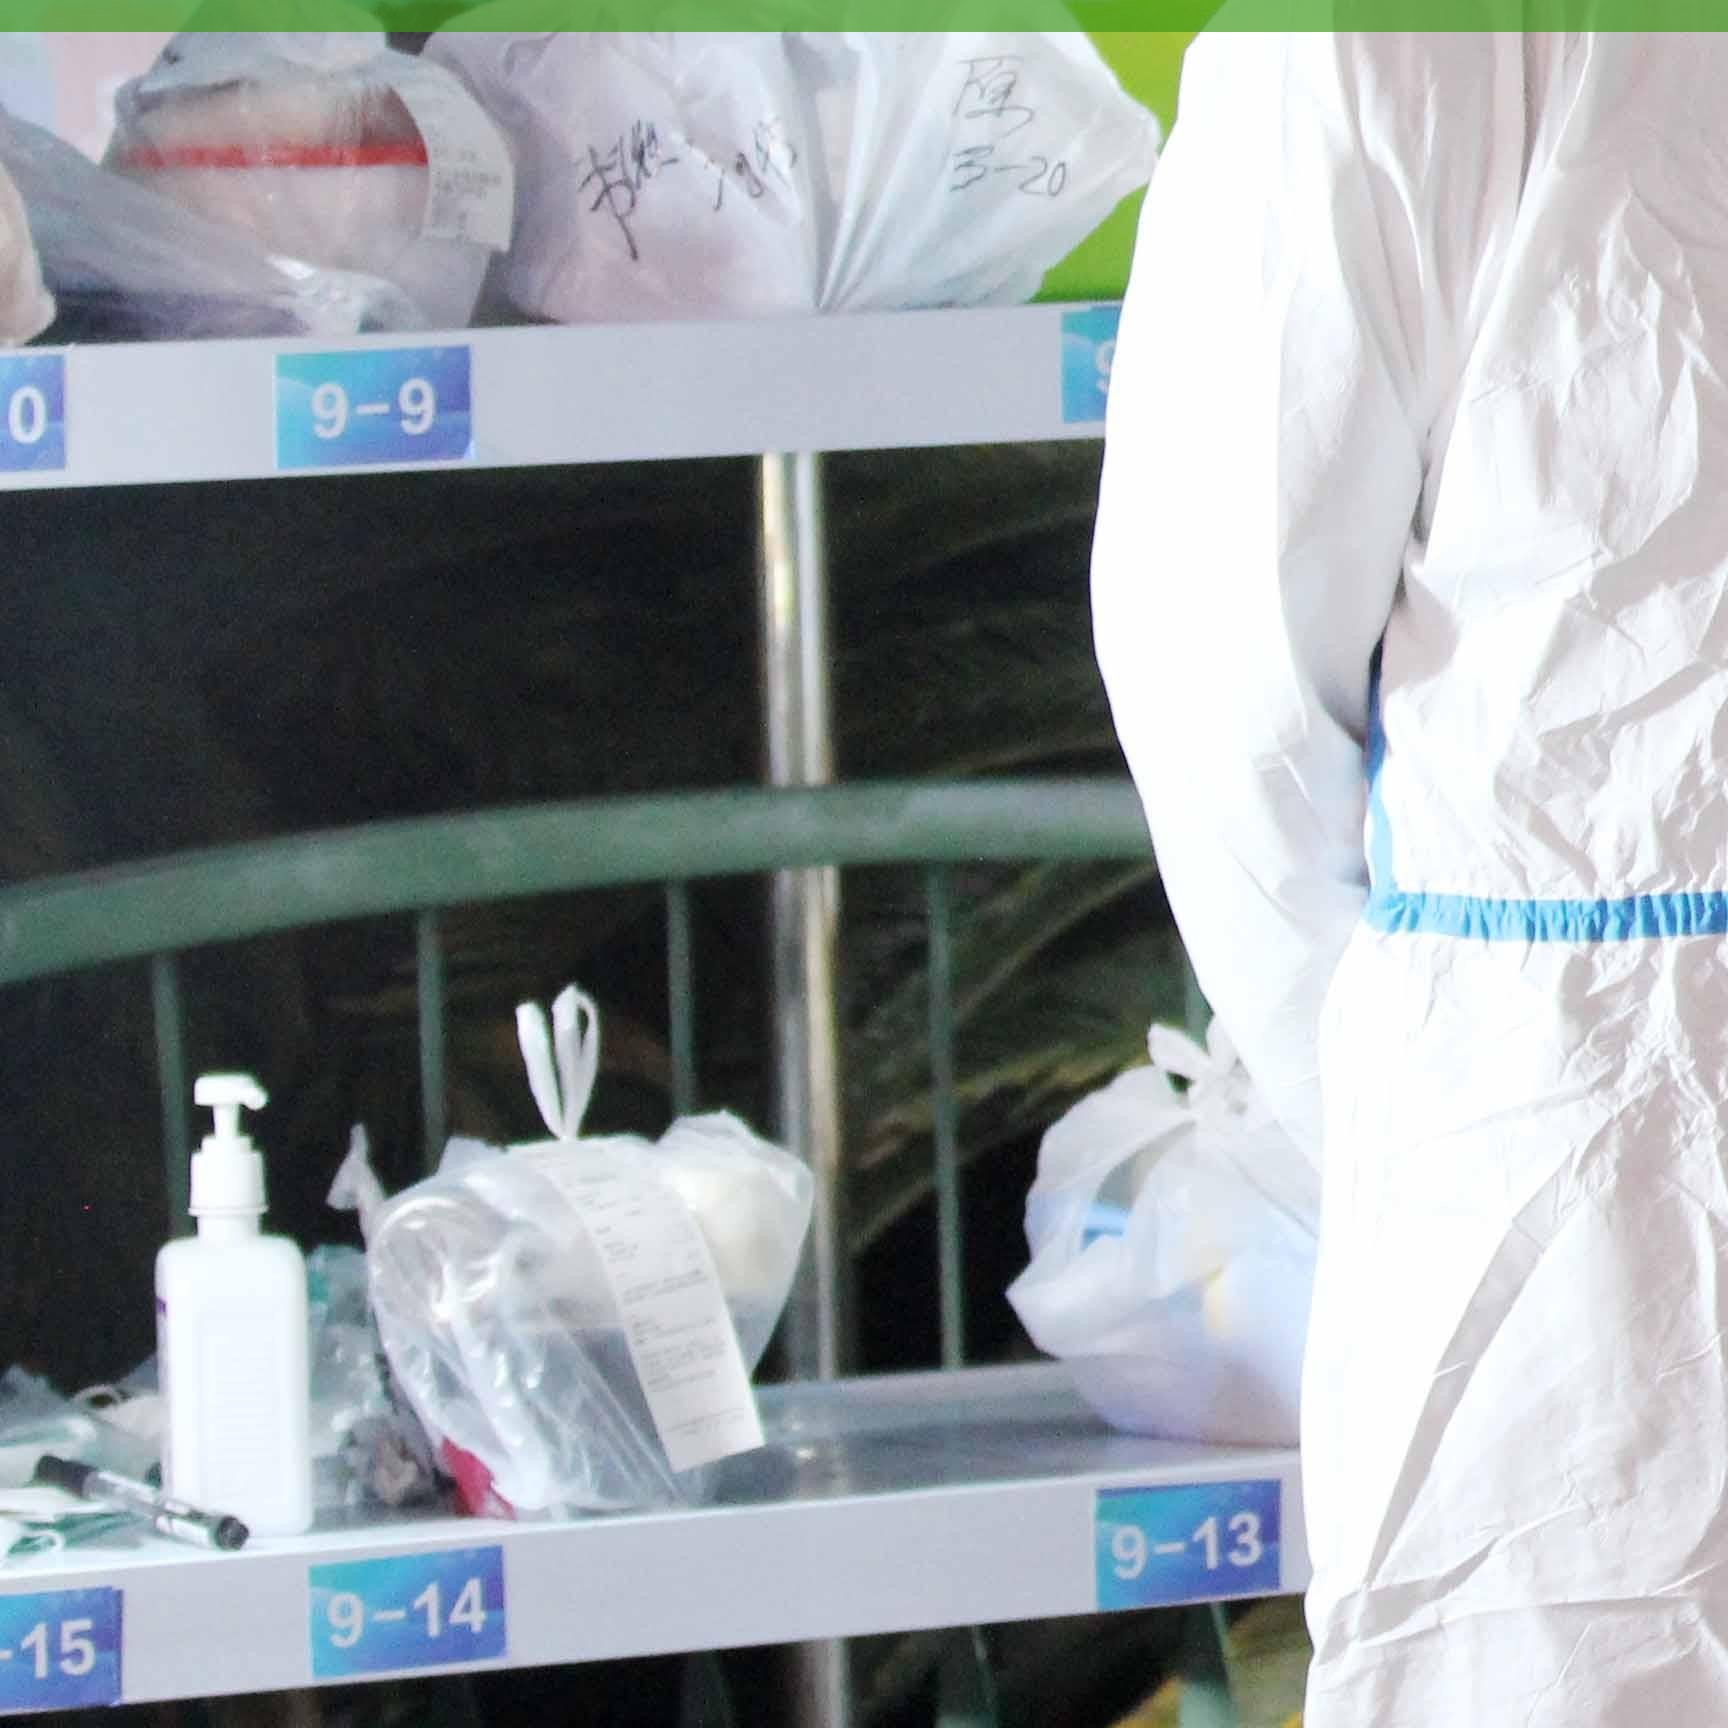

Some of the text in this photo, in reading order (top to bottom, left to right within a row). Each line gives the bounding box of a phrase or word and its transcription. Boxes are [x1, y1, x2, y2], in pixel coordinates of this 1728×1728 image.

[310, 377, 437, 440] 9-9
[1109, 1512, 1264, 1581] 9-13
[325, 1575, 487, 1650] 9-14
